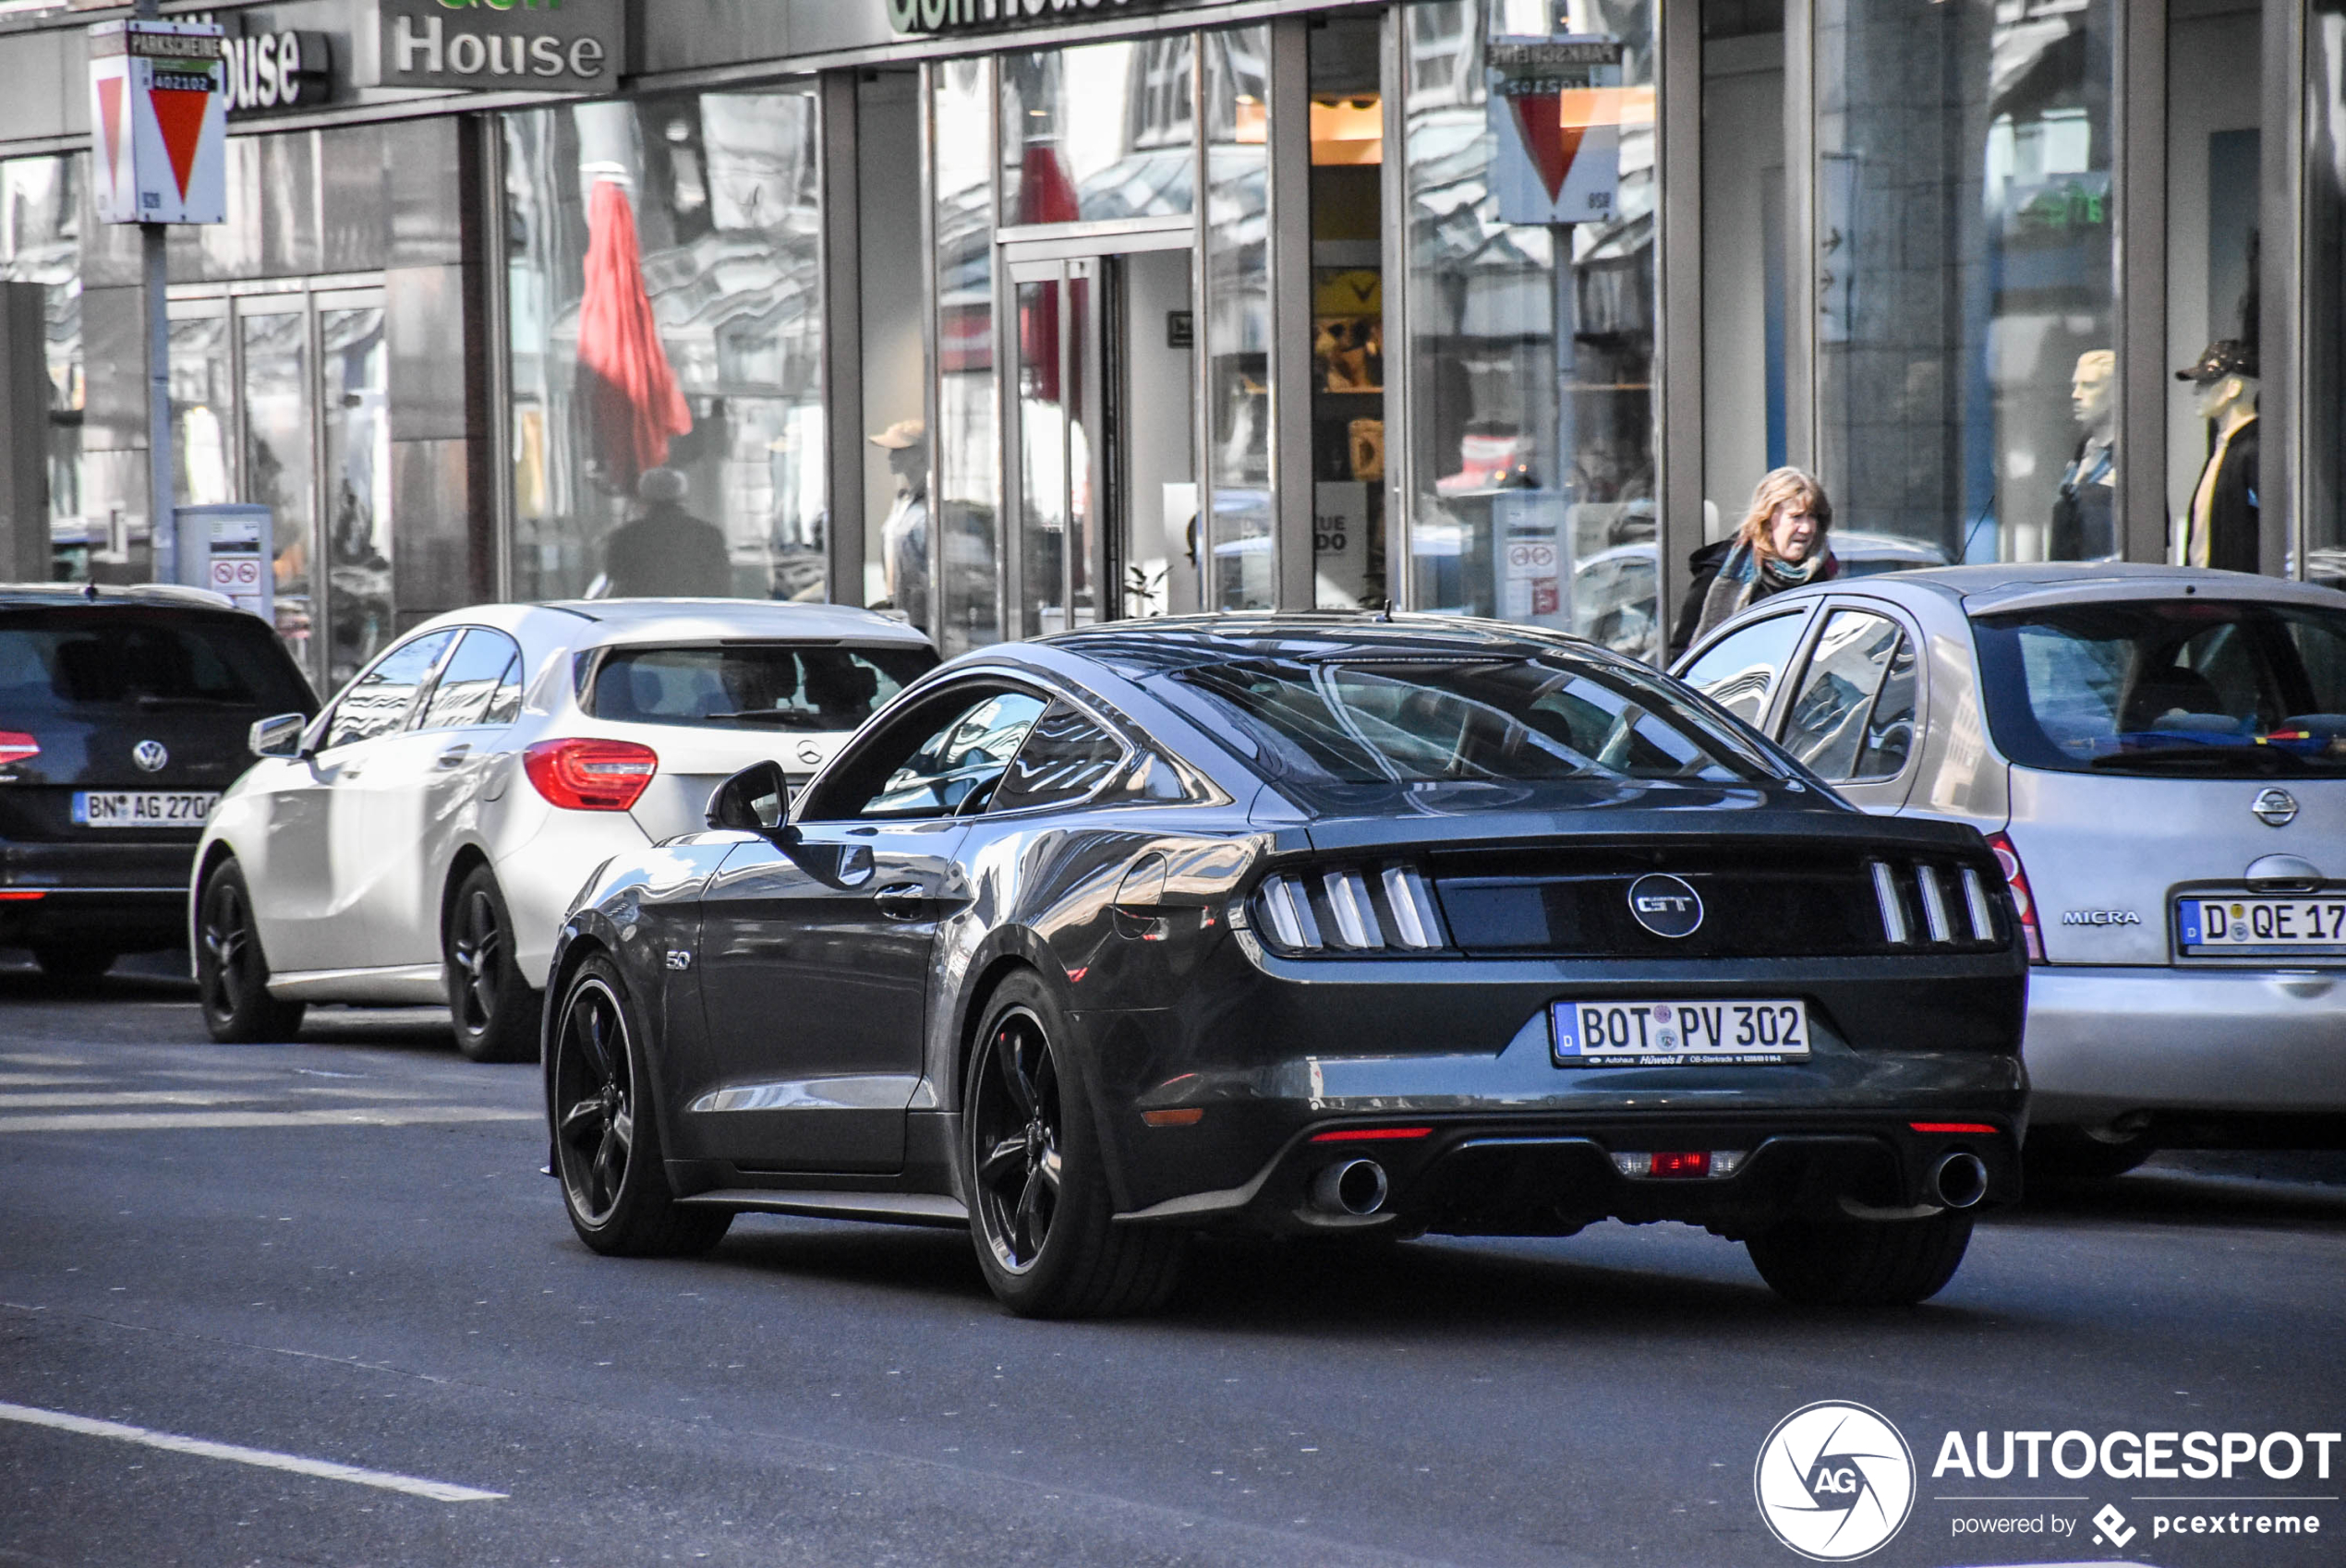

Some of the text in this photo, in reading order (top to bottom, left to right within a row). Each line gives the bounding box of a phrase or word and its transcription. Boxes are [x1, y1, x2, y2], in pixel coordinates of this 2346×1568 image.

[397, 15, 603, 78] House
[89, 796, 117, 818] BN
[134, 795, 161, 818] AG
[1637, 896, 1692, 912] GT
[2062, 911, 2140, 924] MICRA
[2205, 903, 2346, 939] D QE 17
[1582, 1005, 1802, 1048] BOT PV 302
[1563, 1035, 1574, 1048] D
